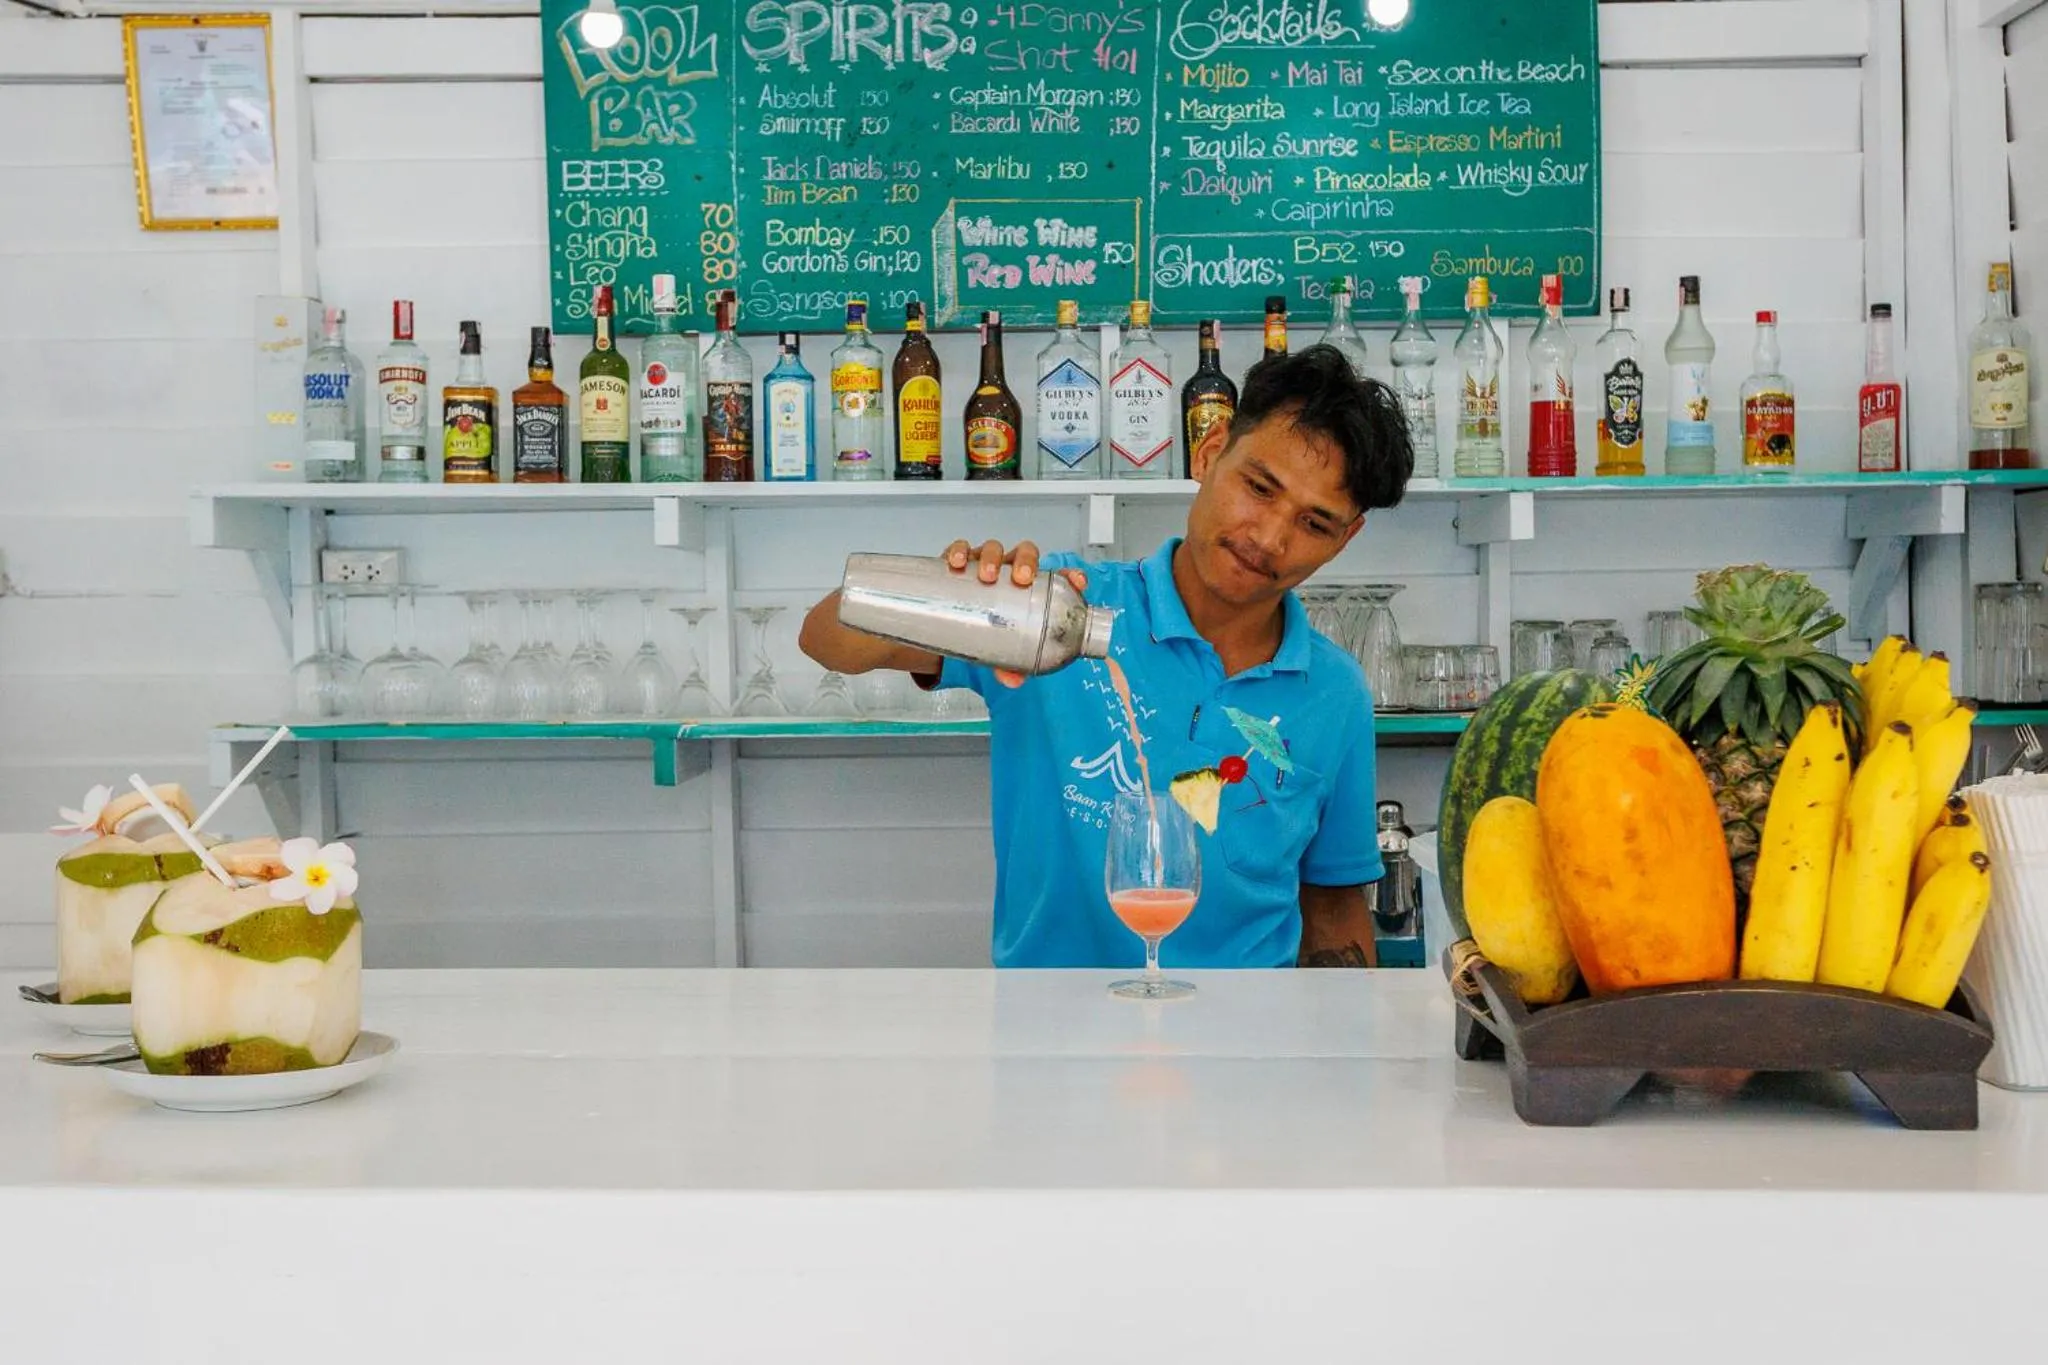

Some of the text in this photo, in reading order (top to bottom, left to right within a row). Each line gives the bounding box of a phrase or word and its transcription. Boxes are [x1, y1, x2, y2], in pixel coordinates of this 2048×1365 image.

[1020, 0, 1146, 50] Danny's
[984, 39, 1081, 72] Shot
[1387, 59, 1441, 86] Sex
[1444, 69, 1480, 84] on
[1517, 55, 1586, 83] Beach
[1183, 62, 1249, 93] Mojito
[1288, 60, 1364, 88] Mai Tai
[758, 82, 837, 109] Absolut
[950, 81, 1022, 111] Captain
[1026, 78, 1105, 117] Morgan
[1333, 91, 1532, 127] Long Island Ice Tea
[590, 85, 697, 152] BAR
[759, 113, 847, 141] Smirnoff
[950, 111, 1021, 133] Bacardi
[1028, 110, 1081, 133] White
[1179, 94, 1287, 131] Margarita
[1181, 131, 1359, 172] Tequila Sunrise
[1388, 124, 1562, 158] Espresso Martini
[562, 158, 666, 191] BEERS
[955, 154, 1031, 181] Marlibu
[1312, 163, 1432, 193] Pinacolada
[1456, 157, 1590, 196] Whisky Sour
[762, 184, 797, 206] Jim
[1181, 166, 1274, 206] Daiquiri
[565, 200, 735, 242] Chang 70
[1271, 193, 1395, 229] Caipirinha
[564, 223, 737, 270] Singha 80
[765, 217, 855, 253] Bombay
[1293, 236, 1358, 265] B52
[1369, 240, 1405, 259] 150
[762, 246, 849, 275] Gordon's
[1102, 242, 1136, 265] 150
[1429, 243, 1584, 277] Sambuca 100
[569, 257, 738, 287] Leo 80
[579, 380, 627, 397] JAMESON
[1049, 410, 1090, 421] VODKA
[1128, 414, 1149, 424] GIN
[1063, 784, 1098, 810] Baan
